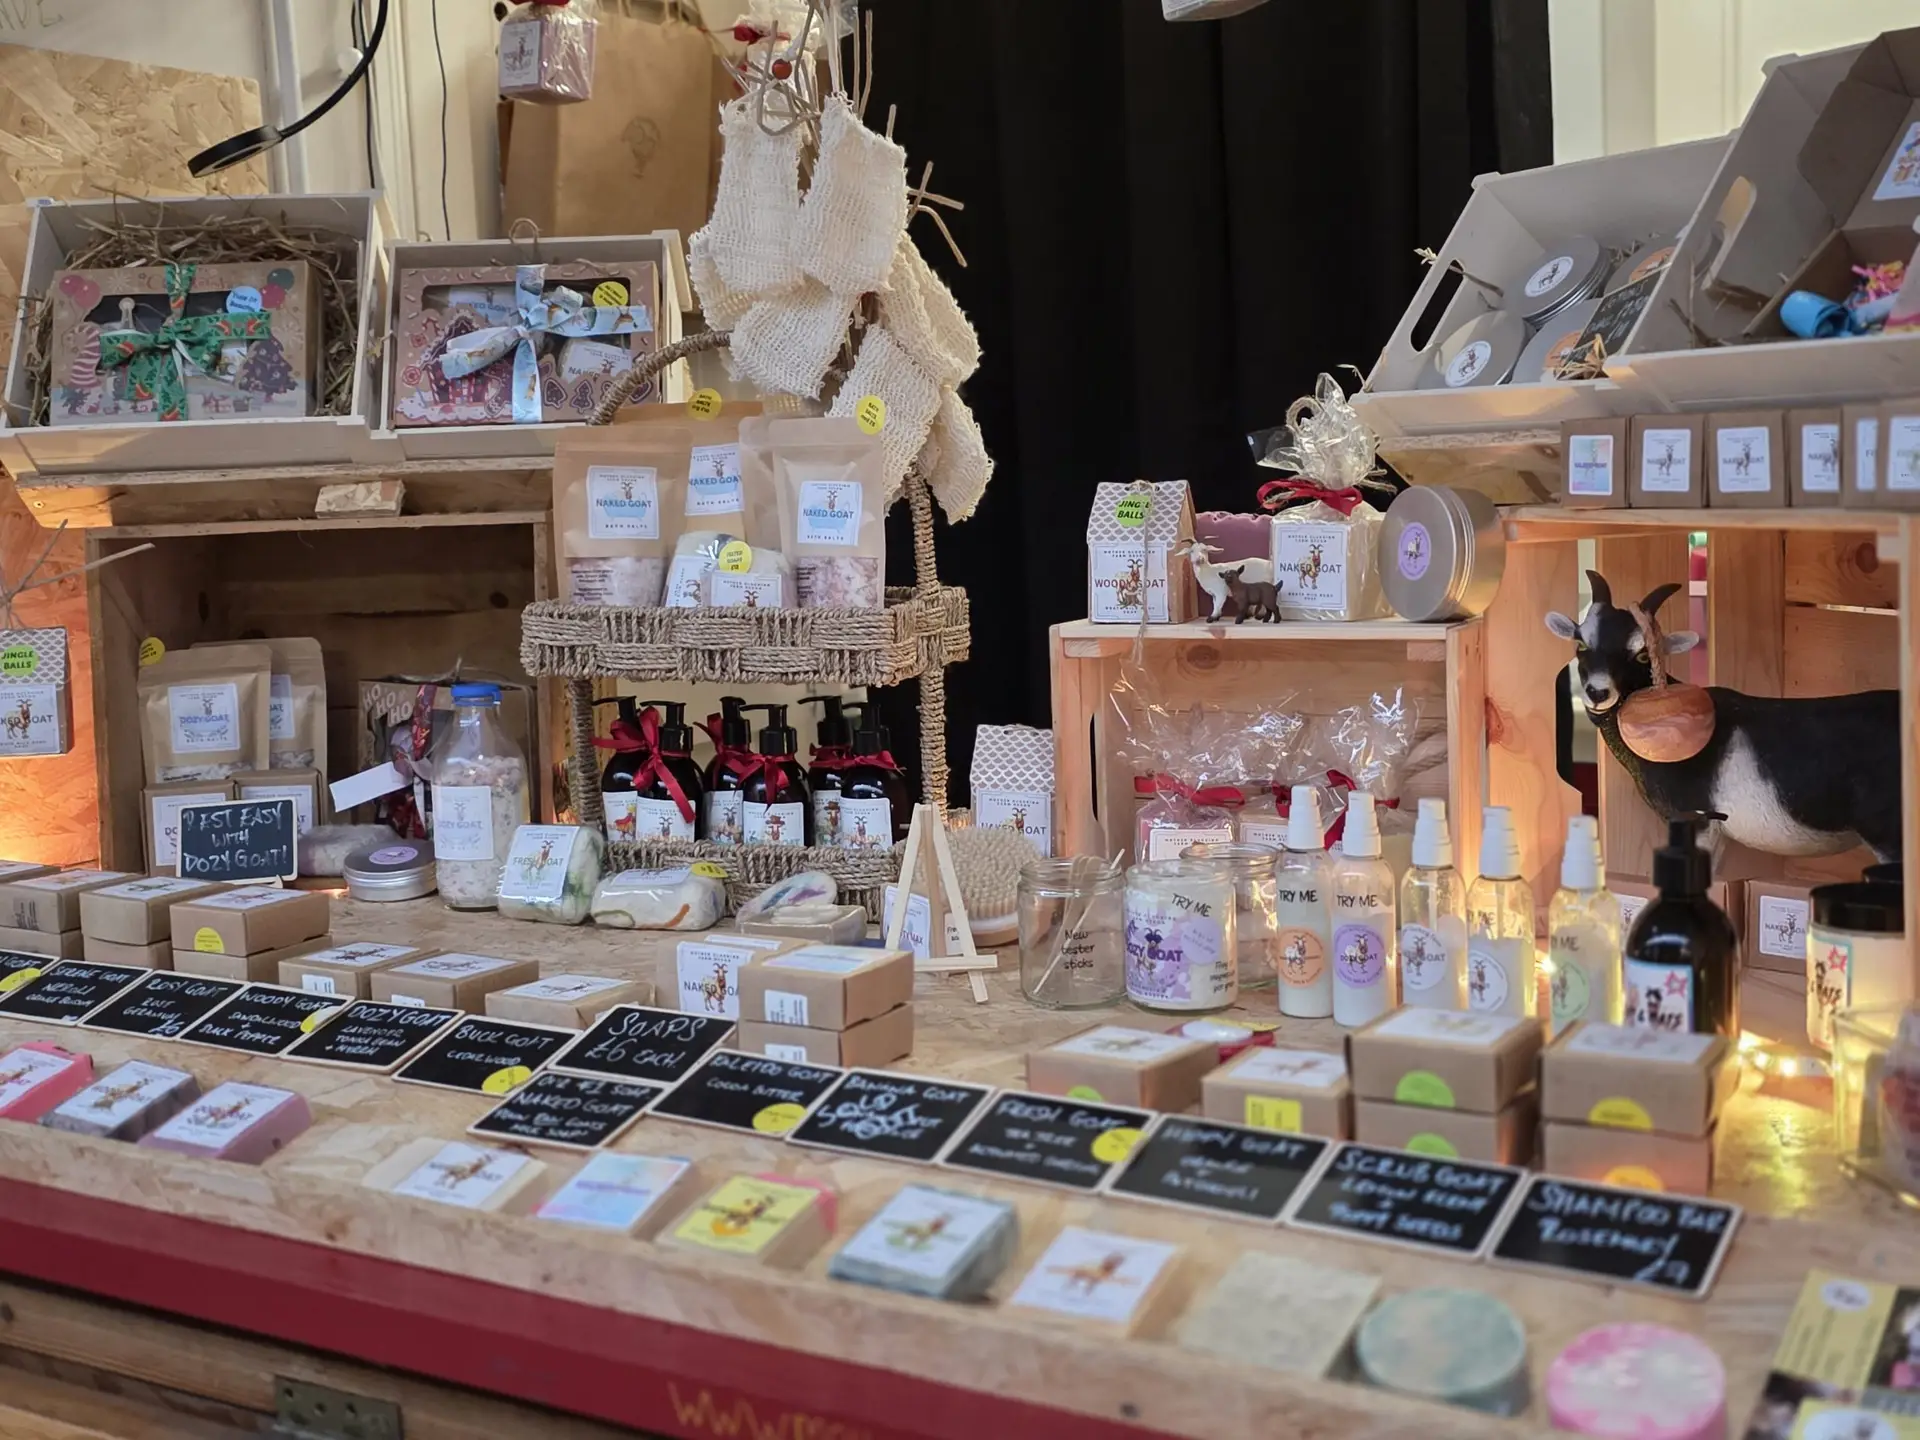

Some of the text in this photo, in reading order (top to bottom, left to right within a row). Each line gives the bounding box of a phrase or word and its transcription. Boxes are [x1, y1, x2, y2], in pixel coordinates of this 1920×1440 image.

[596, 499, 652, 509] NAKED GOAT
[803, 508, 855, 520] NAKED GOAT
[1117, 510, 1145, 520] BALLS
[1280, 562, 1342, 575] NAKED GOAT
[1, 649, 35, 660] JINGLE
[3, 660, 33, 671] BALLS
[239, 801, 284, 831] EASY
[211, 828, 250, 849] WITH
[182, 844, 288, 873] DOZY GOAT!
[1171, 892, 1213, 918] TRY ME
[1278, 889, 1318, 903] TRY ME
[1336, 894, 1379, 908] TRY ME
[1064, 930, 1089, 941] New
[1061, 943, 1096, 955] tester
[1146, 948, 1184, 964] GOAT
[1062, 959, 1095, 970] sticks
[145, 978, 229, 998] ROSY GOAT
[683, 981, 718, 994] NAKED
[240, 990, 334, 1013] WOODY GOAT
[347, 1004, 453, 1028] DOZY GOAT
[340, 1024, 405, 1038] LAVENDER
[608, 1011, 708, 1042] SOAPS
[454, 1024, 556, 1050] BUCK GOAT
[584, 1036, 638, 1062] £6
[709, 1054, 835, 1083] KALEIDO GOAT
[706, 1076, 804, 1102] COCOA BUTTER
[921, 1086, 971, 1103] GOAT
[511, 1090, 635, 1117] NAKED GOAT
[1240, 1134, 1307, 1160] GOAT
[1335, 1150, 1510, 1197] SCRUB GOAT
[1525, 1182, 1729, 1234] SHAMPOO BAR
